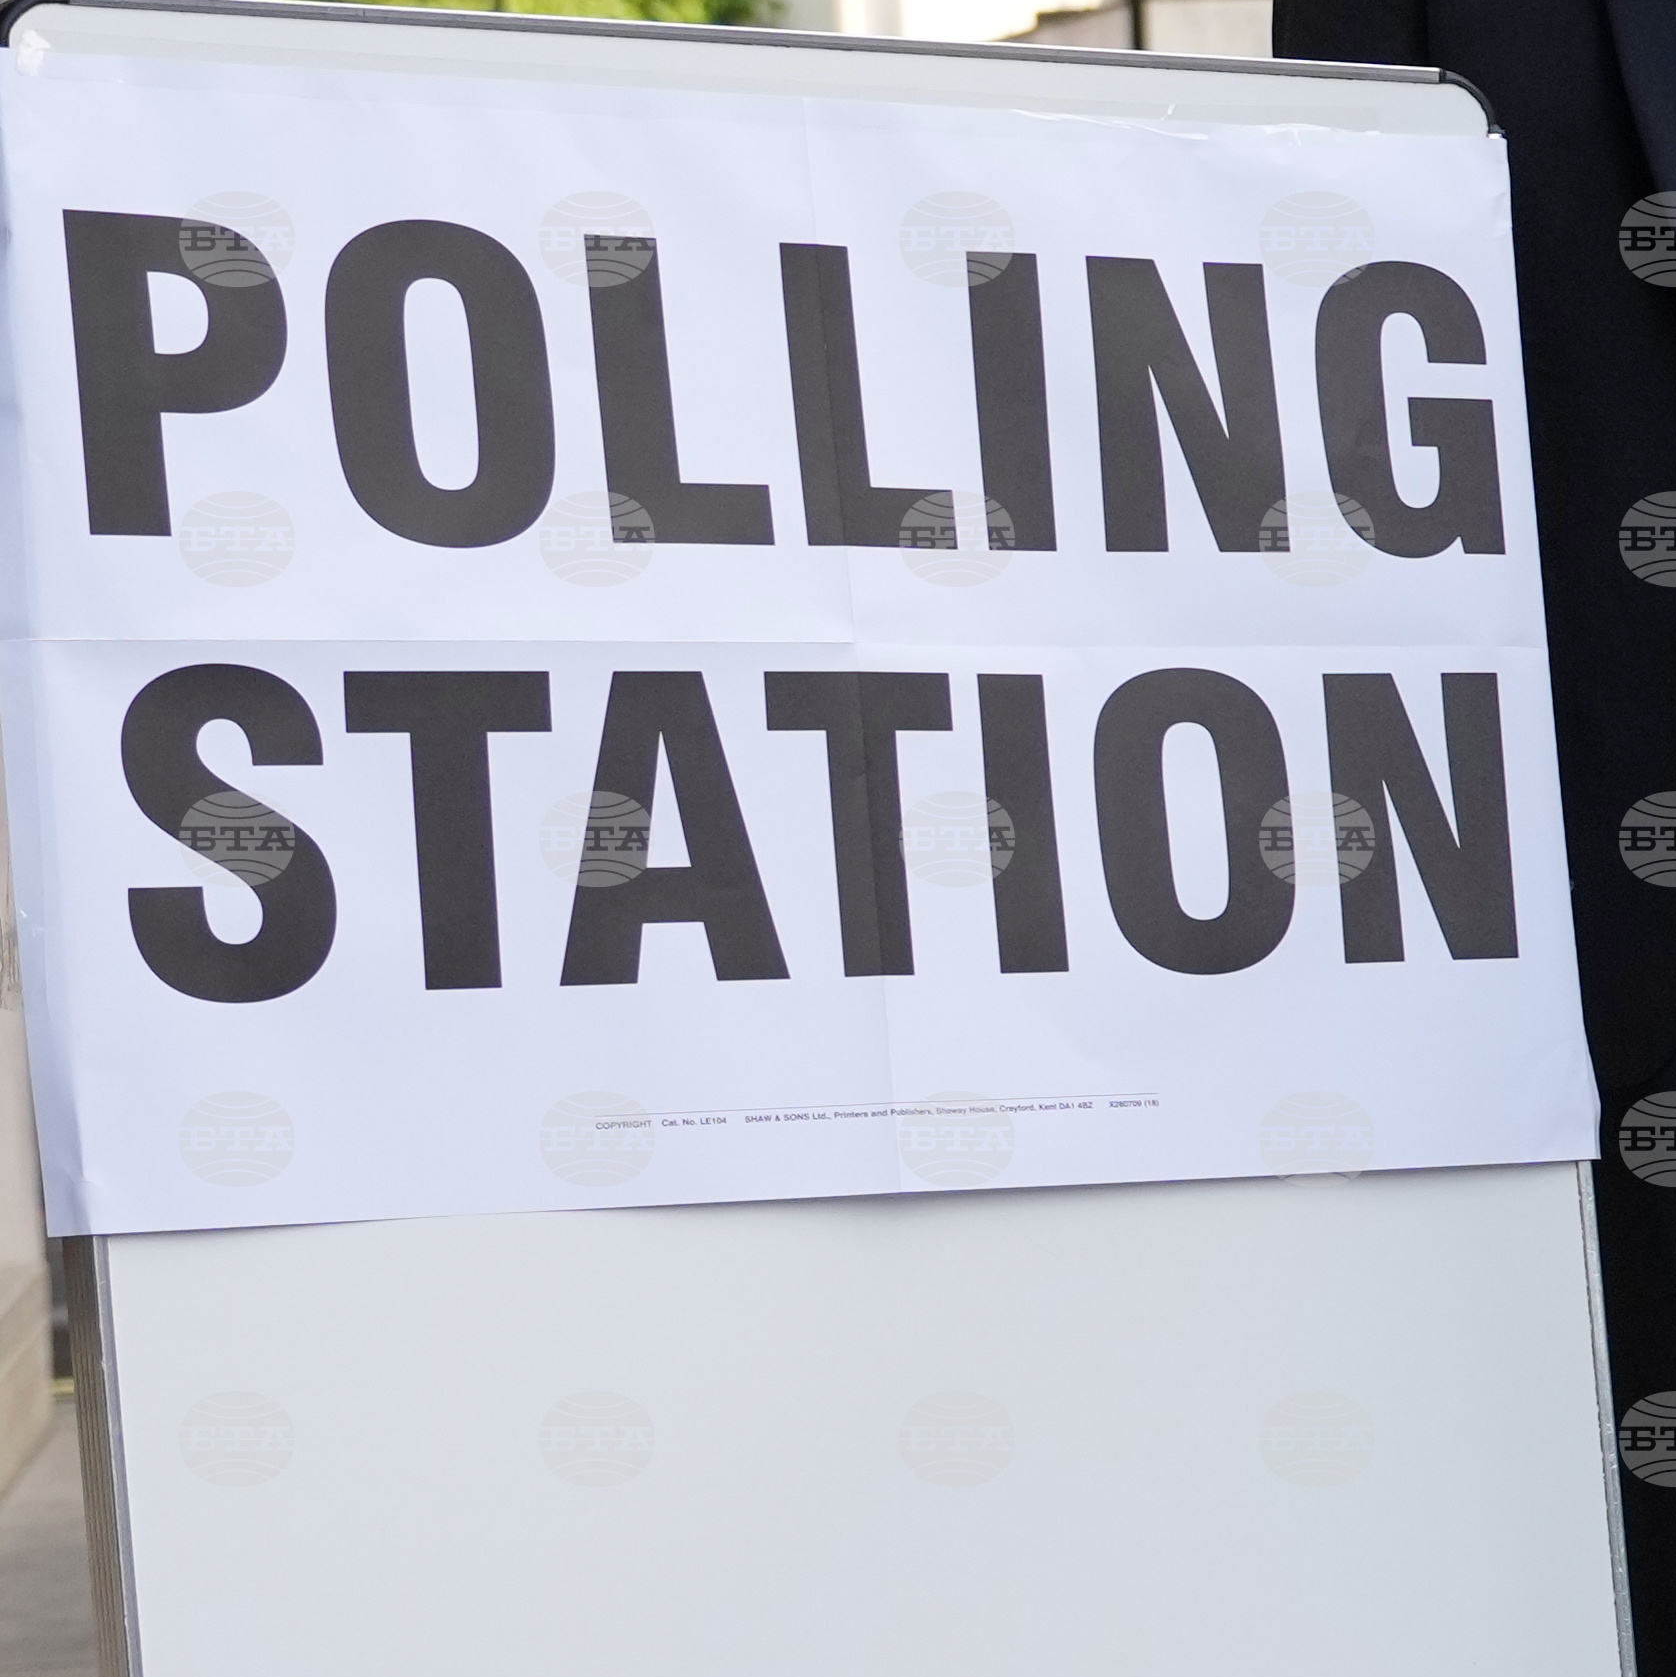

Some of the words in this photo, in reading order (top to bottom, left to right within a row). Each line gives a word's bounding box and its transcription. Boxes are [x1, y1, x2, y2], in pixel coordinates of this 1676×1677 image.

[62, 208, 1506, 559] POLLING
[120, 662, 1519, 1004] STATION
[596, 1120, 652, 1130] COPYRIGHT
[661, 1119, 679, 1127] Cat.
[683, 1117, 697, 1125] No.
[700, 1117, 727, 1125] LE104
[744, 1114, 772, 1123] SHAW
[774, 1114, 781, 1122] &
[784, 1113, 810, 1121] SONS
[834, 1110, 868, 1119] Printers
[871, 1109, 887, 1117] and
[999, 1104, 1036, 1113] Crayford,
[1077, 1101, 1094, 1109] 4BZ
